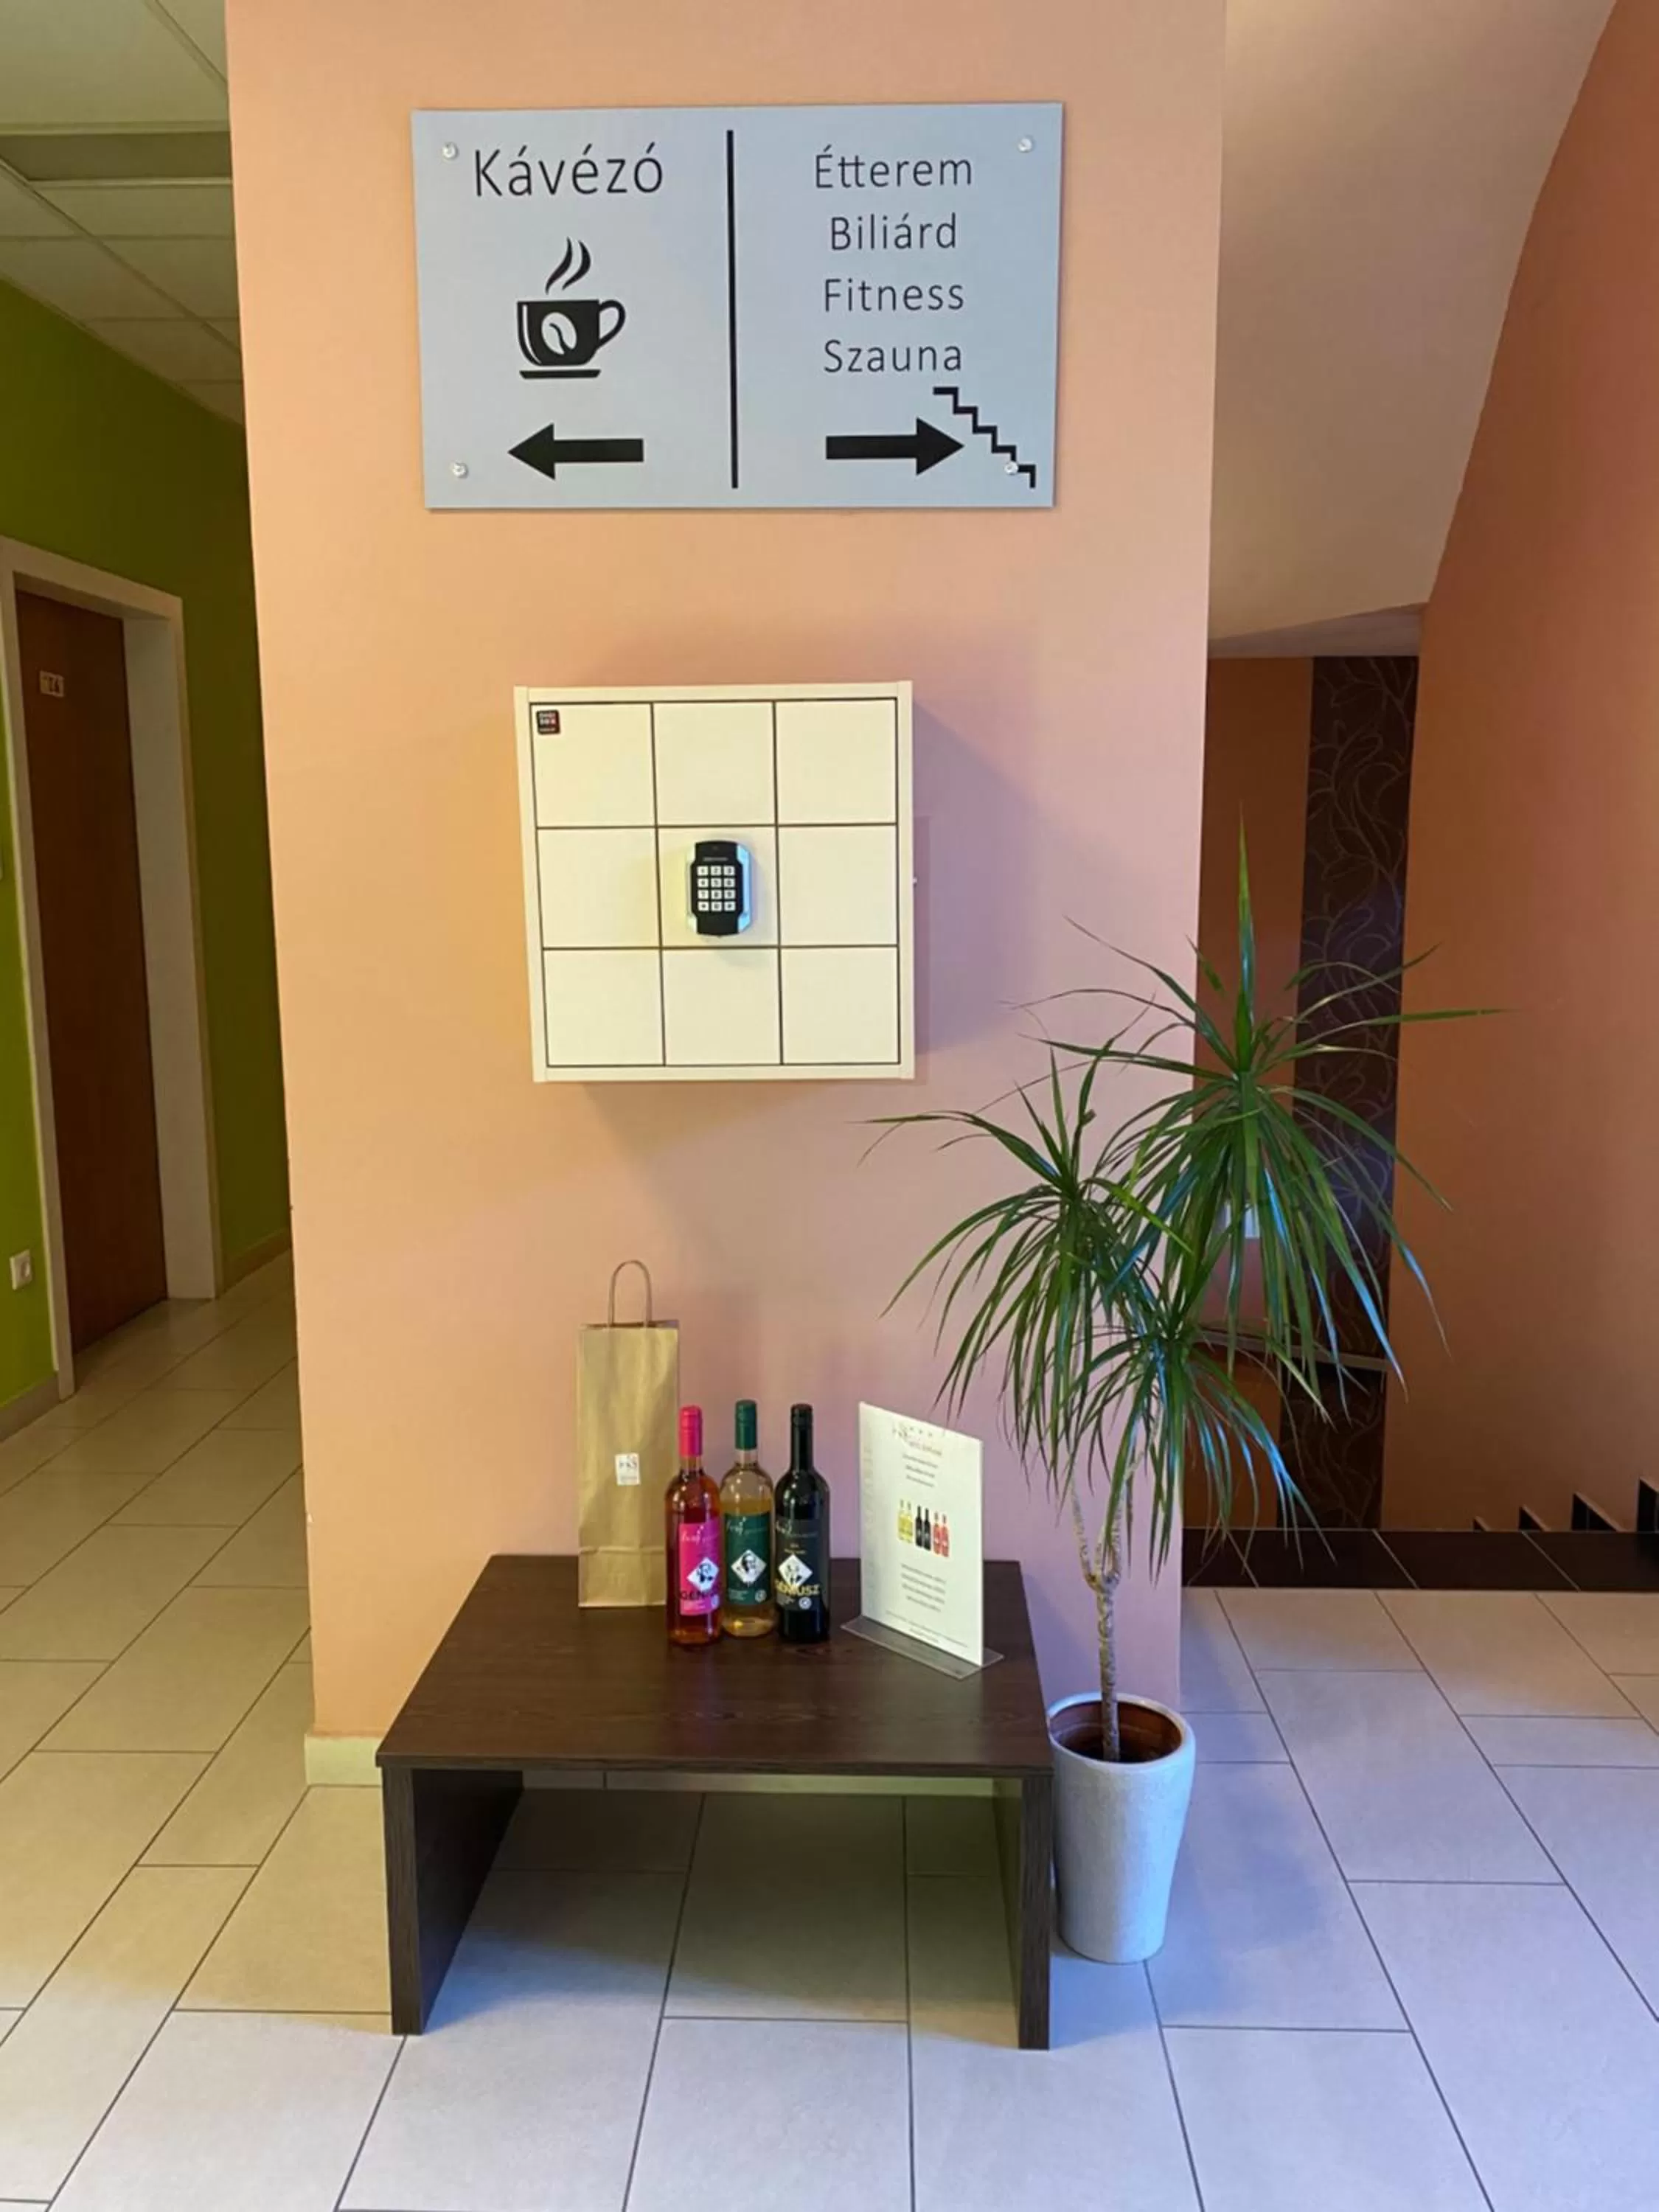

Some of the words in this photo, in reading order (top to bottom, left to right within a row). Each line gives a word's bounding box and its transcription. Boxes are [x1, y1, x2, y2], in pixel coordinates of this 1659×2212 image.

[476, 142, 663, 197] Kávézó
[815, 145, 971, 189] Étterem
[832, 212, 956, 251] Biliárd
[825, 278, 964, 312] Fitness
[824, 339, 961, 373] Szauna
